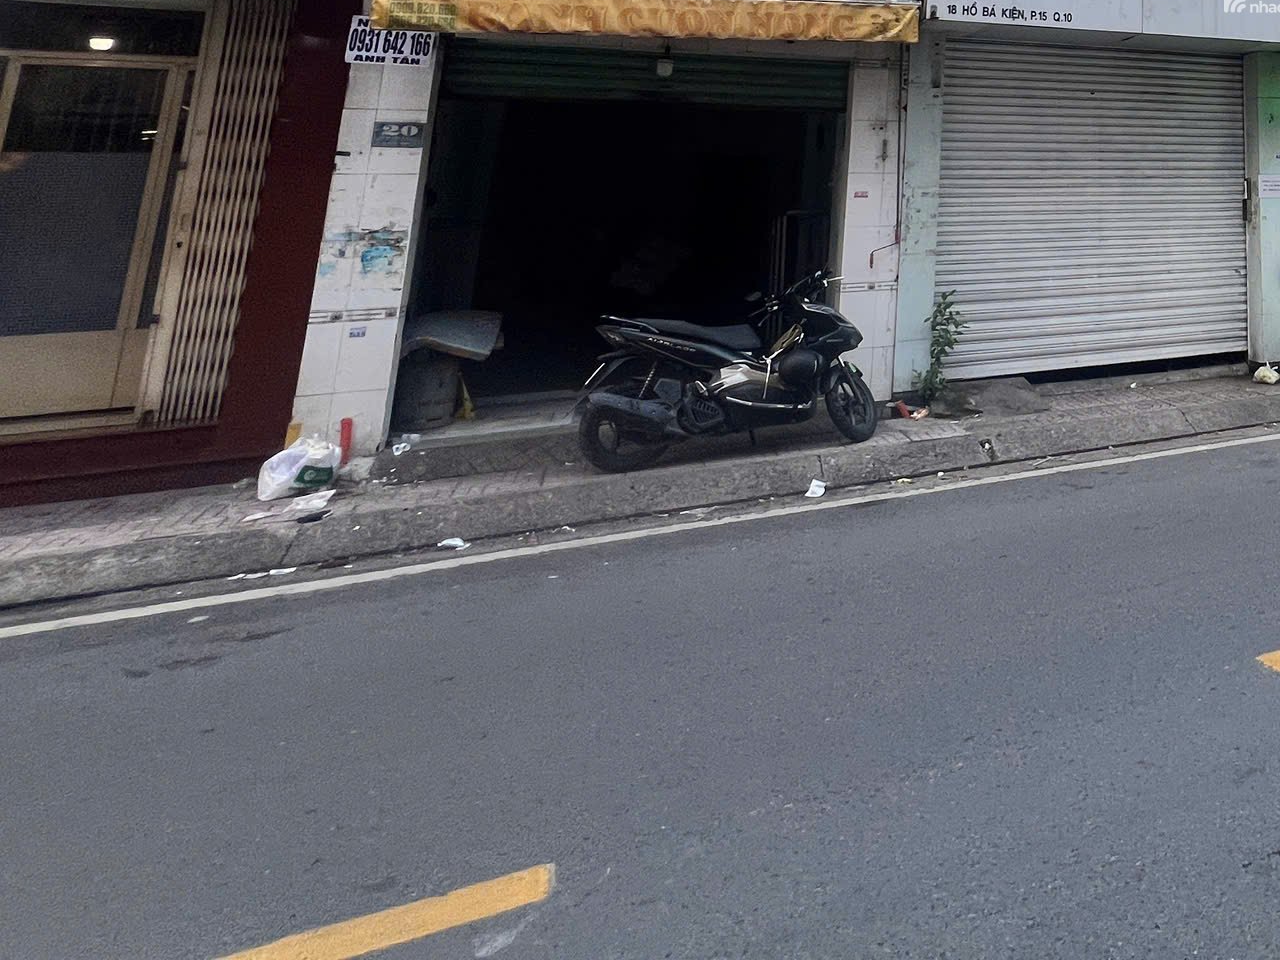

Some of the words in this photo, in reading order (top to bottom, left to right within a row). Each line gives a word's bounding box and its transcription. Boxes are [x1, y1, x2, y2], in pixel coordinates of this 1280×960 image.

[947, 4, 957, 15] 18
[982, 4, 996, 17] BÁ
[1001, 6, 1027, 21] KIỆN,
[1030, 10, 1047, 21] P.15
[1053, 11, 1072, 22] Q.10
[348, 28, 381, 53] 0931
[382, 30, 409, 55] 642
[410, 32, 432, 56] 166
[353, 54, 385, 63] ANH
[381, 123, 419, 137] 20
